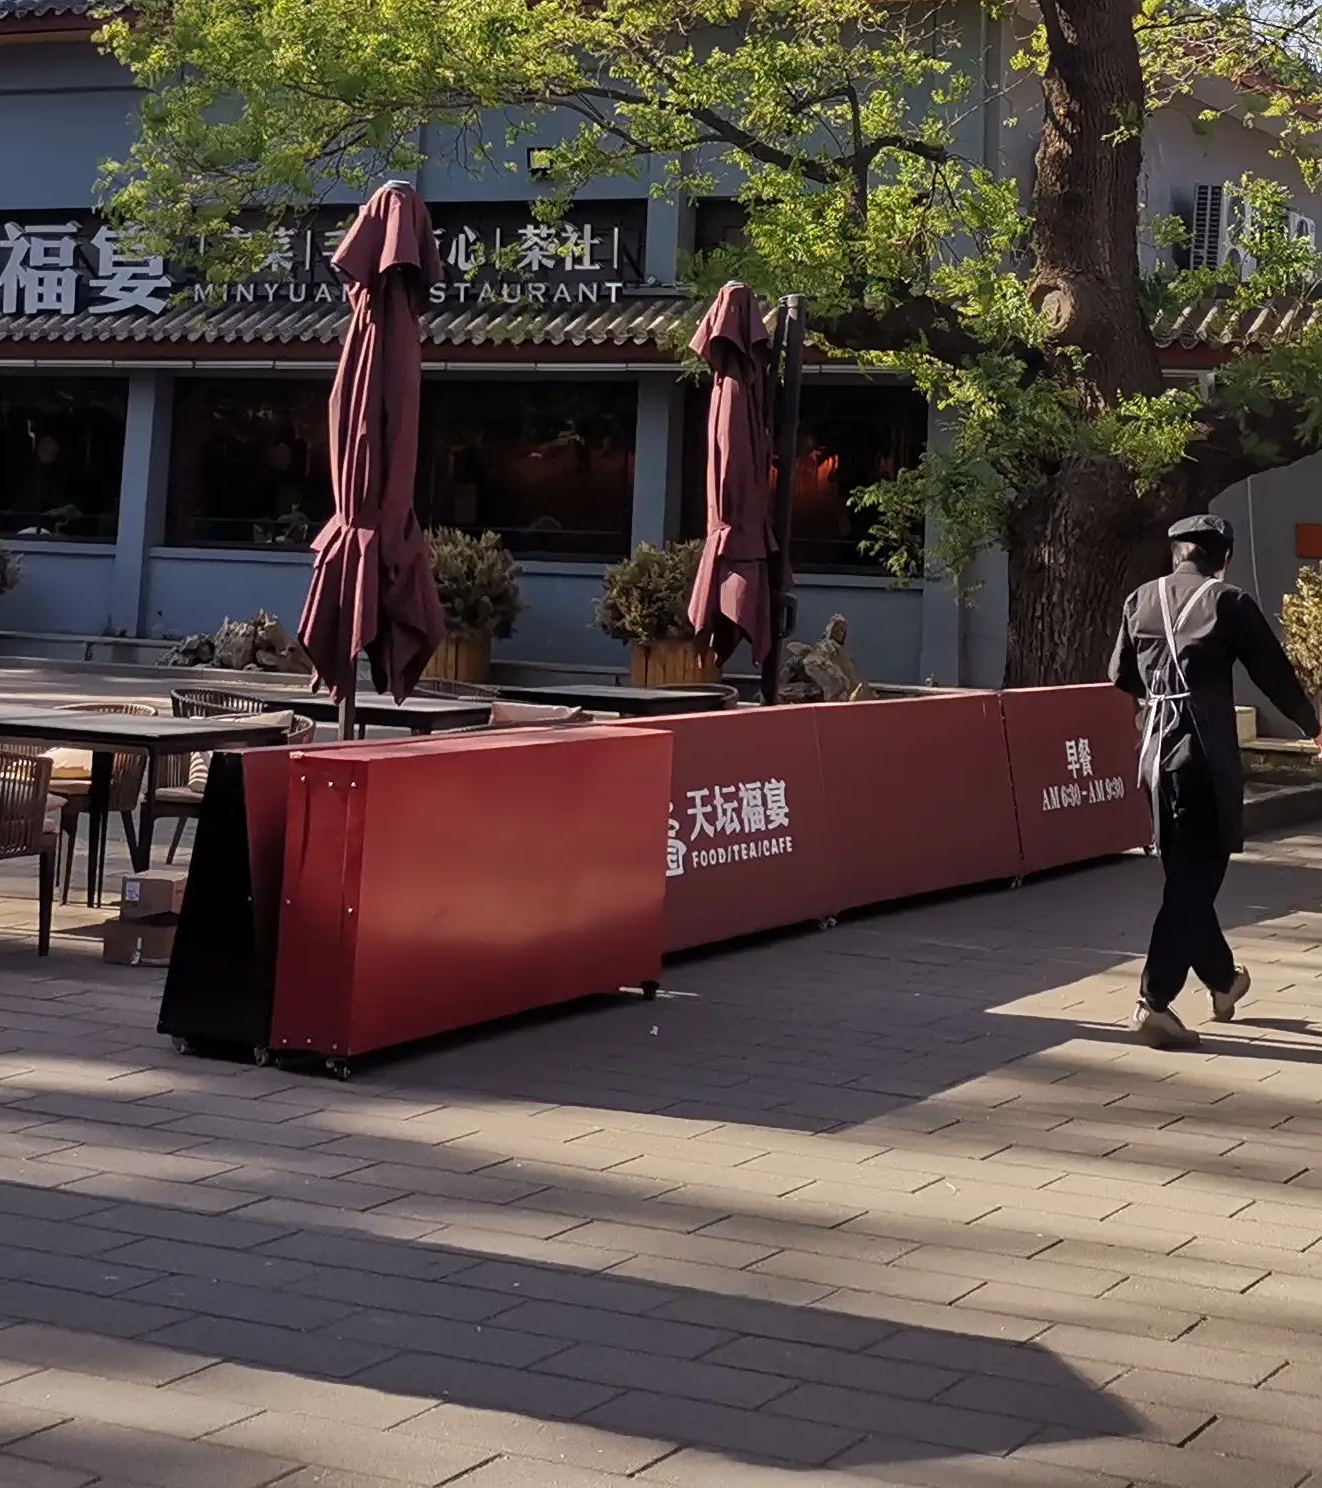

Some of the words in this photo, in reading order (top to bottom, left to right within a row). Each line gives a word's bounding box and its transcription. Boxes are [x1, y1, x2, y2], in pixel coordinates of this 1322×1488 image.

[429, 282, 623, 304] STAURANT
[1065, 737, 1093, 779] 早餐
[686, 778, 790, 842] 天坛福宴
[1042, 786, 1061, 811] AM
[1088, 779, 1106, 804] AM
[691, 836, 793, 868] FOOD/TEA/CAFE
